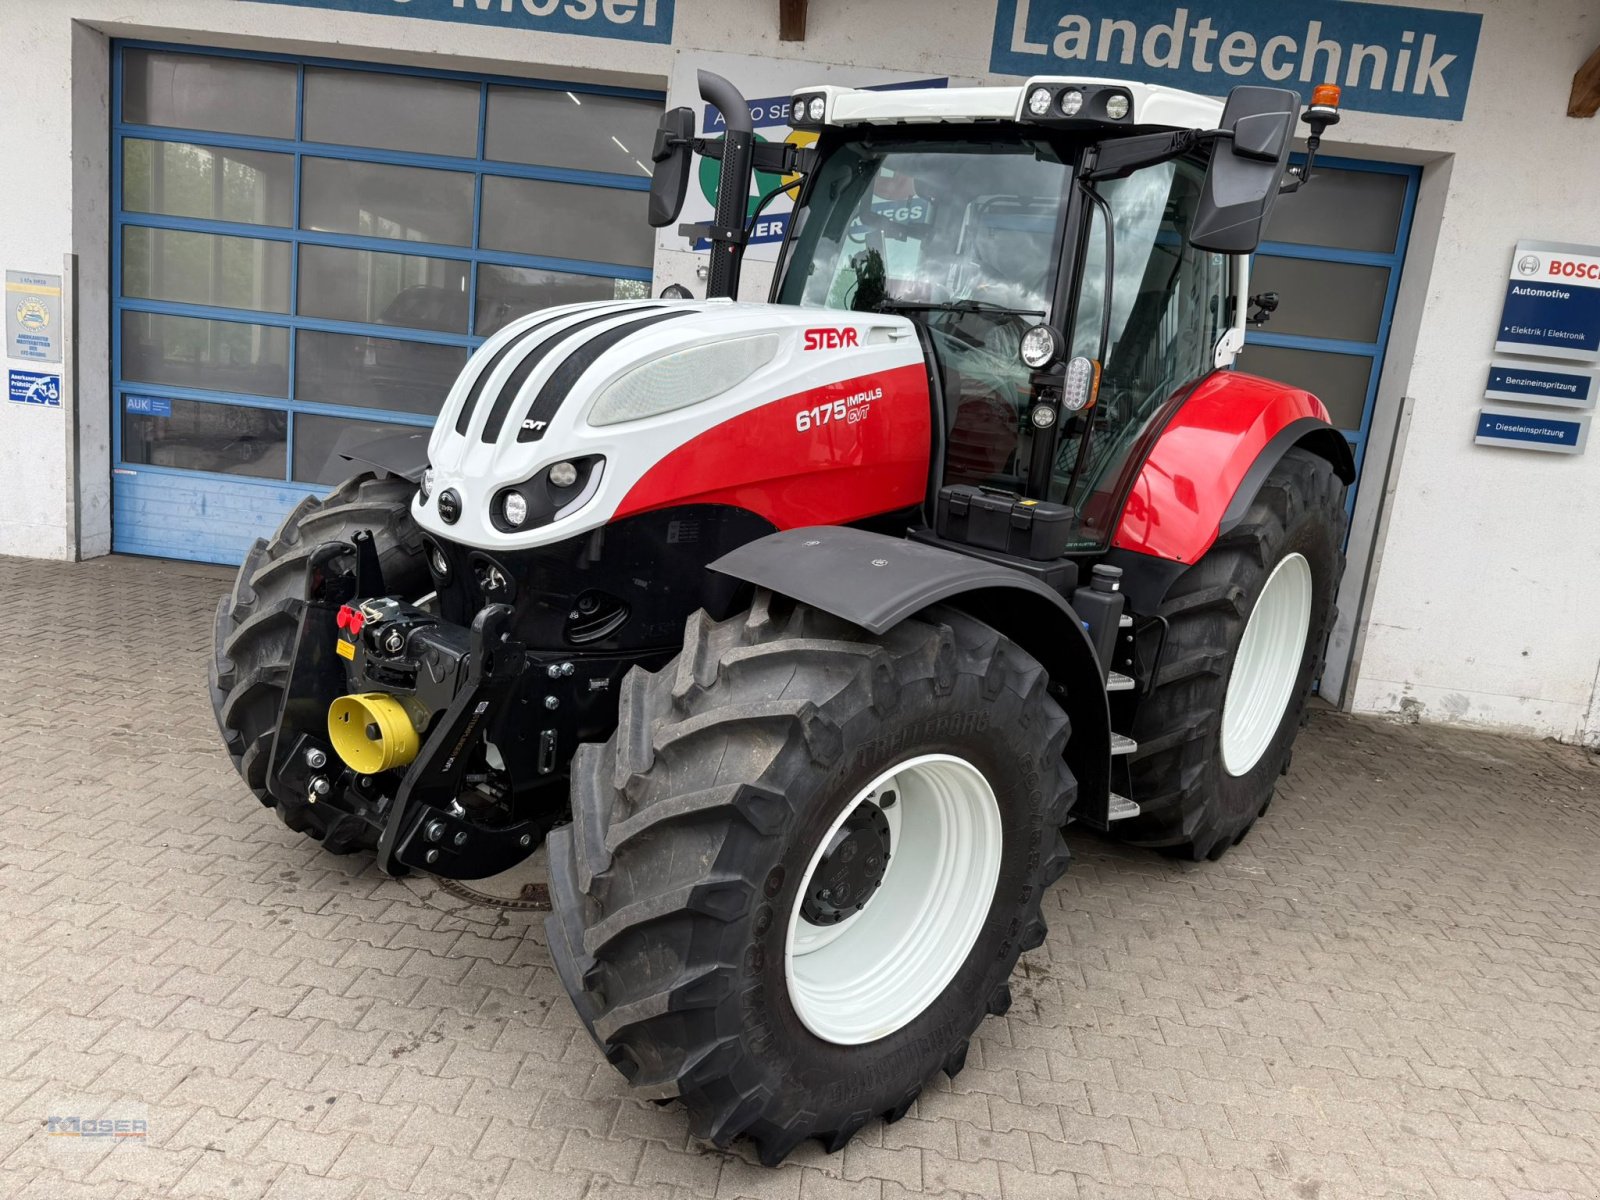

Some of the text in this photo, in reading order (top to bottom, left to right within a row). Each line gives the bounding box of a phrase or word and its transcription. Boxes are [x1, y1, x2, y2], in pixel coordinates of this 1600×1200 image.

[1010, 0, 1457, 98] Landtechnik
[1549, 260, 1600, 279] BOSC
[1512, 286, 1571, 300] Automotive
[804, 326, 859, 351] STEYR
[1510, 325, 1541, 337] Elektrik
[1547, 329, 1586, 341] Elektronik
[1505, 376, 1577, 392] Benzineinspritzung
[127, 399, 148, 410] AUK
[796, 387, 883, 432] 6175 IMPULS
[847, 404, 870, 424] CVT
[521, 418, 547, 431] CVT
[1495, 423, 1565, 438] Dieseleinspritzung
